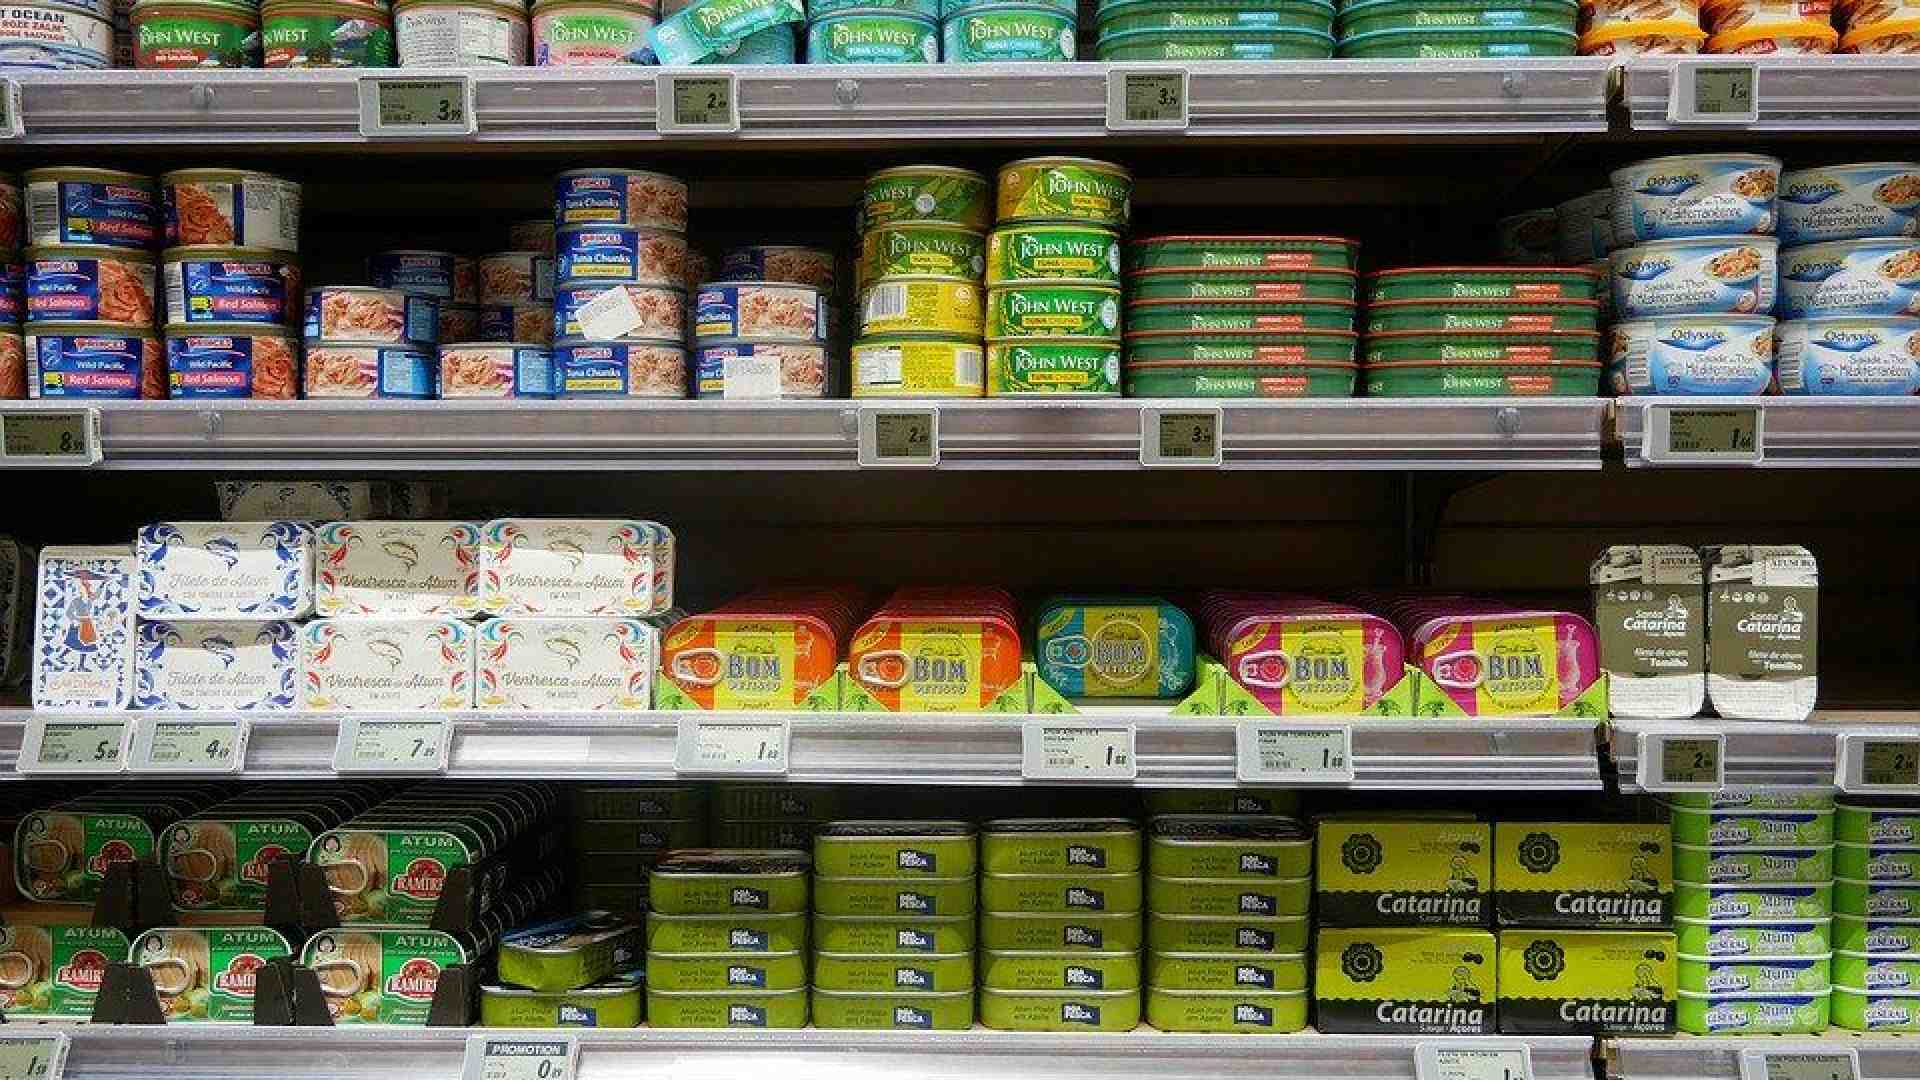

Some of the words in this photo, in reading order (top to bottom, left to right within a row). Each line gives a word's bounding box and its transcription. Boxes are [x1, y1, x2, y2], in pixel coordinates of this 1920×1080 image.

[11, 10, 65, 23] OCEAN
[175, 30, 222, 46] WEST
[272, 30, 309, 43] WEST
[552, 24, 590, 42] JOHN
[592, 25, 635, 42] WEST
[832, 25, 874, 48] JOHN
[878, 31, 917, 47] WEST
[970, 21, 1011, 45] JOHN
[1014, 24, 1054, 41] WEST
[880, 186, 915, 200] WEST
[1049, 176, 1090, 196] JOHN
[584, 198, 618, 208] Chunks
[890, 238, 931, 256] JOHN
[935, 240, 971, 256] WEST
[1021, 238, 1062, 258] JOHN
[1066, 240, 1105, 256] WEST
[572, 253, 594, 263] Tuna
[596, 253, 631, 264] Chunks
[51, 297, 85, 308] Salmon
[1011, 298, 1050, 317] JOHN
[1055, 298, 1095, 314] WEST
[77, 360, 96, 369] Wild
[1016, 355, 1055, 375] JOHN
[1060, 355, 1099, 371] WEST
[201, 374, 241, 385] Salmon
[586, 367, 621, 378] Chunks
[69, 375, 89, 386] Red
[90, 375, 131, 387] Salmon
[339, 575, 408, 590] Ventresca
[506, 575, 574, 590] Ventresca
[1622, 617, 1687, 631] Catarina
[1736, 619, 1802, 634] Catarina
[1096, 640, 1145, 662] BOM
[728, 654, 780, 679] BOM
[913, 657, 966, 682] BOM
[1294, 656, 1350, 680] BOM
[1487, 654, 1544, 680] BOM
[326, 675, 395, 689] Ventresca
[503, 675, 571, 689] Ventresca
[95, 818, 142, 830] ATUM
[248, 823, 301, 834] ATUM
[400, 835, 455, 847] ATUM
[1377, 893, 1481, 916] Catarina
[1555, 893, 1663, 916] Catarina
[64, 928, 118, 939] ATUM
[222, 932, 277, 943] ATUM
[395, 936, 449, 947] ATUM
[1376, 1002, 1483, 1025] Catarina
[1559, 1001, 1667, 1024] Catarina
[491, 1044, 563, 1056] PROMOTION
